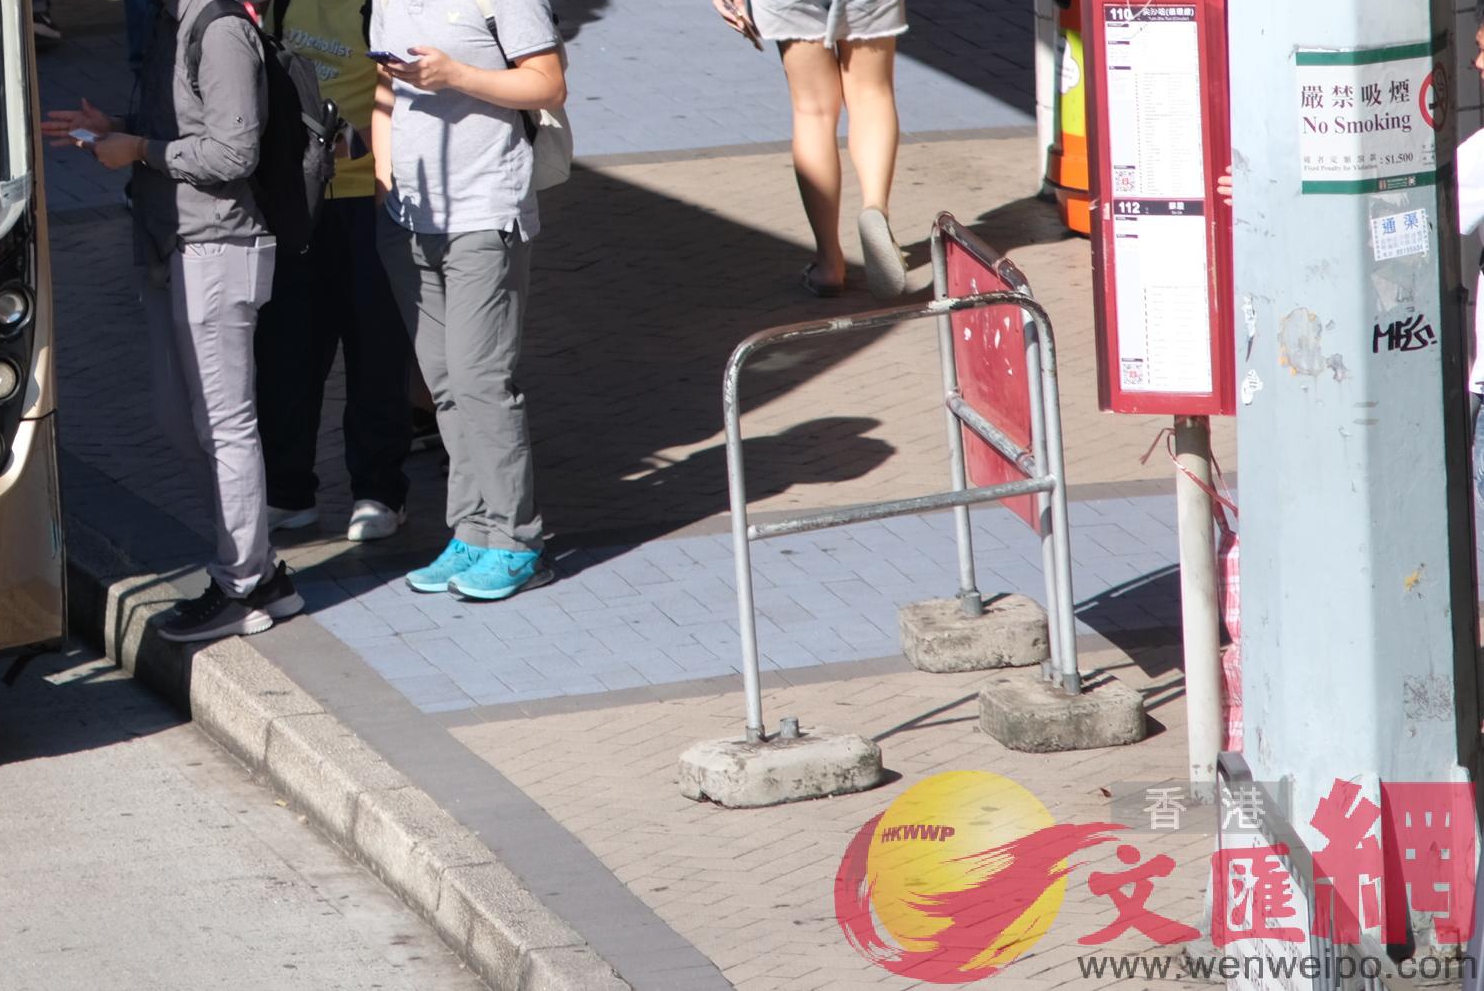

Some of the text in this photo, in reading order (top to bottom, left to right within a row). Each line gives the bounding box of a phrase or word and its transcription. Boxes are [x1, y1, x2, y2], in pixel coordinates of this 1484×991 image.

[1110, 8, 1131, 20] 110
[1301, 78, 1411, 109] 嚴禁吸煙
[1303, 112, 1412, 134] No Smoking
[1118, 201, 1141, 214] 112
